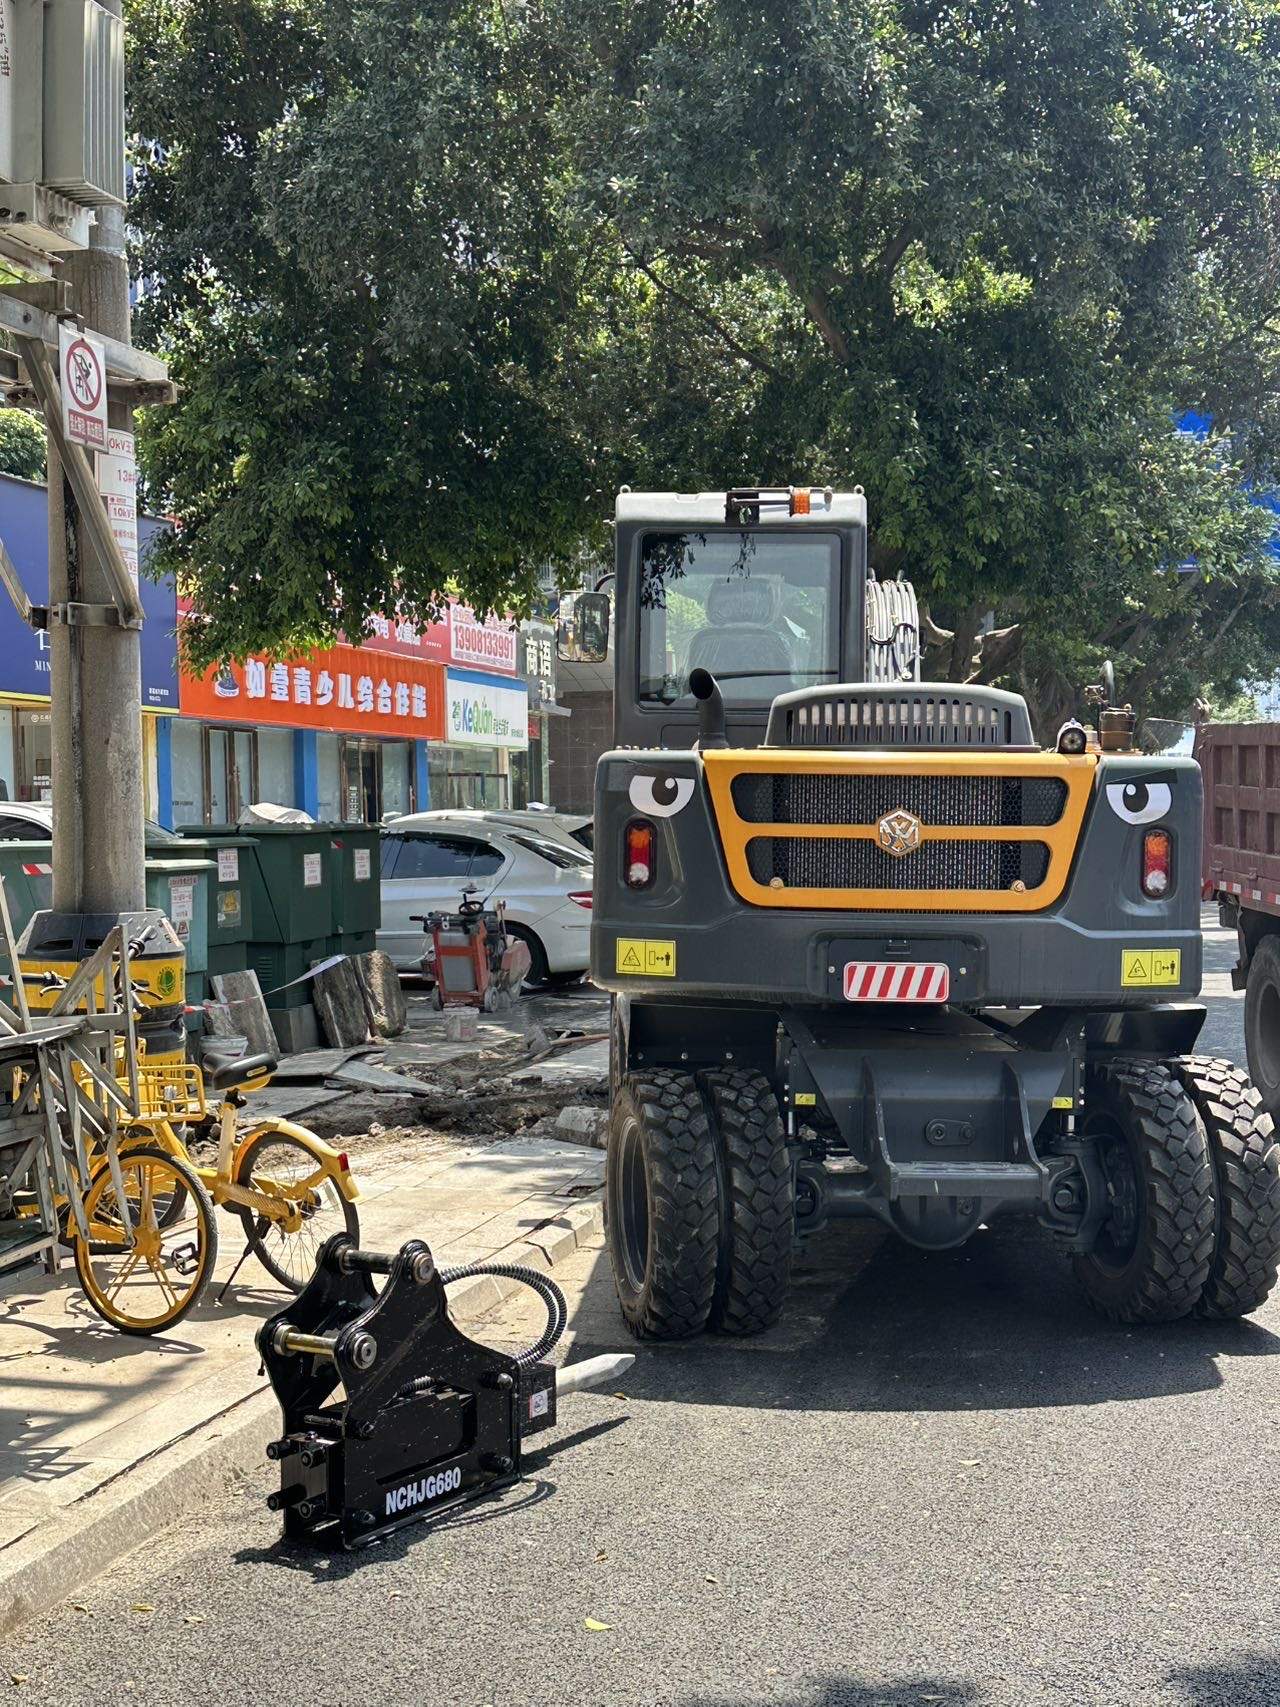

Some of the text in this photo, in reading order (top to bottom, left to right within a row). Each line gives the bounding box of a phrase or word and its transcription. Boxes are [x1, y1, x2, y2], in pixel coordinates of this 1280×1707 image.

[454, 624, 514, 660] 13908133991
[245, 657, 427, 718] 如壹青少儿综合体能
[385, 1466, 462, 1516] NCHJG680
